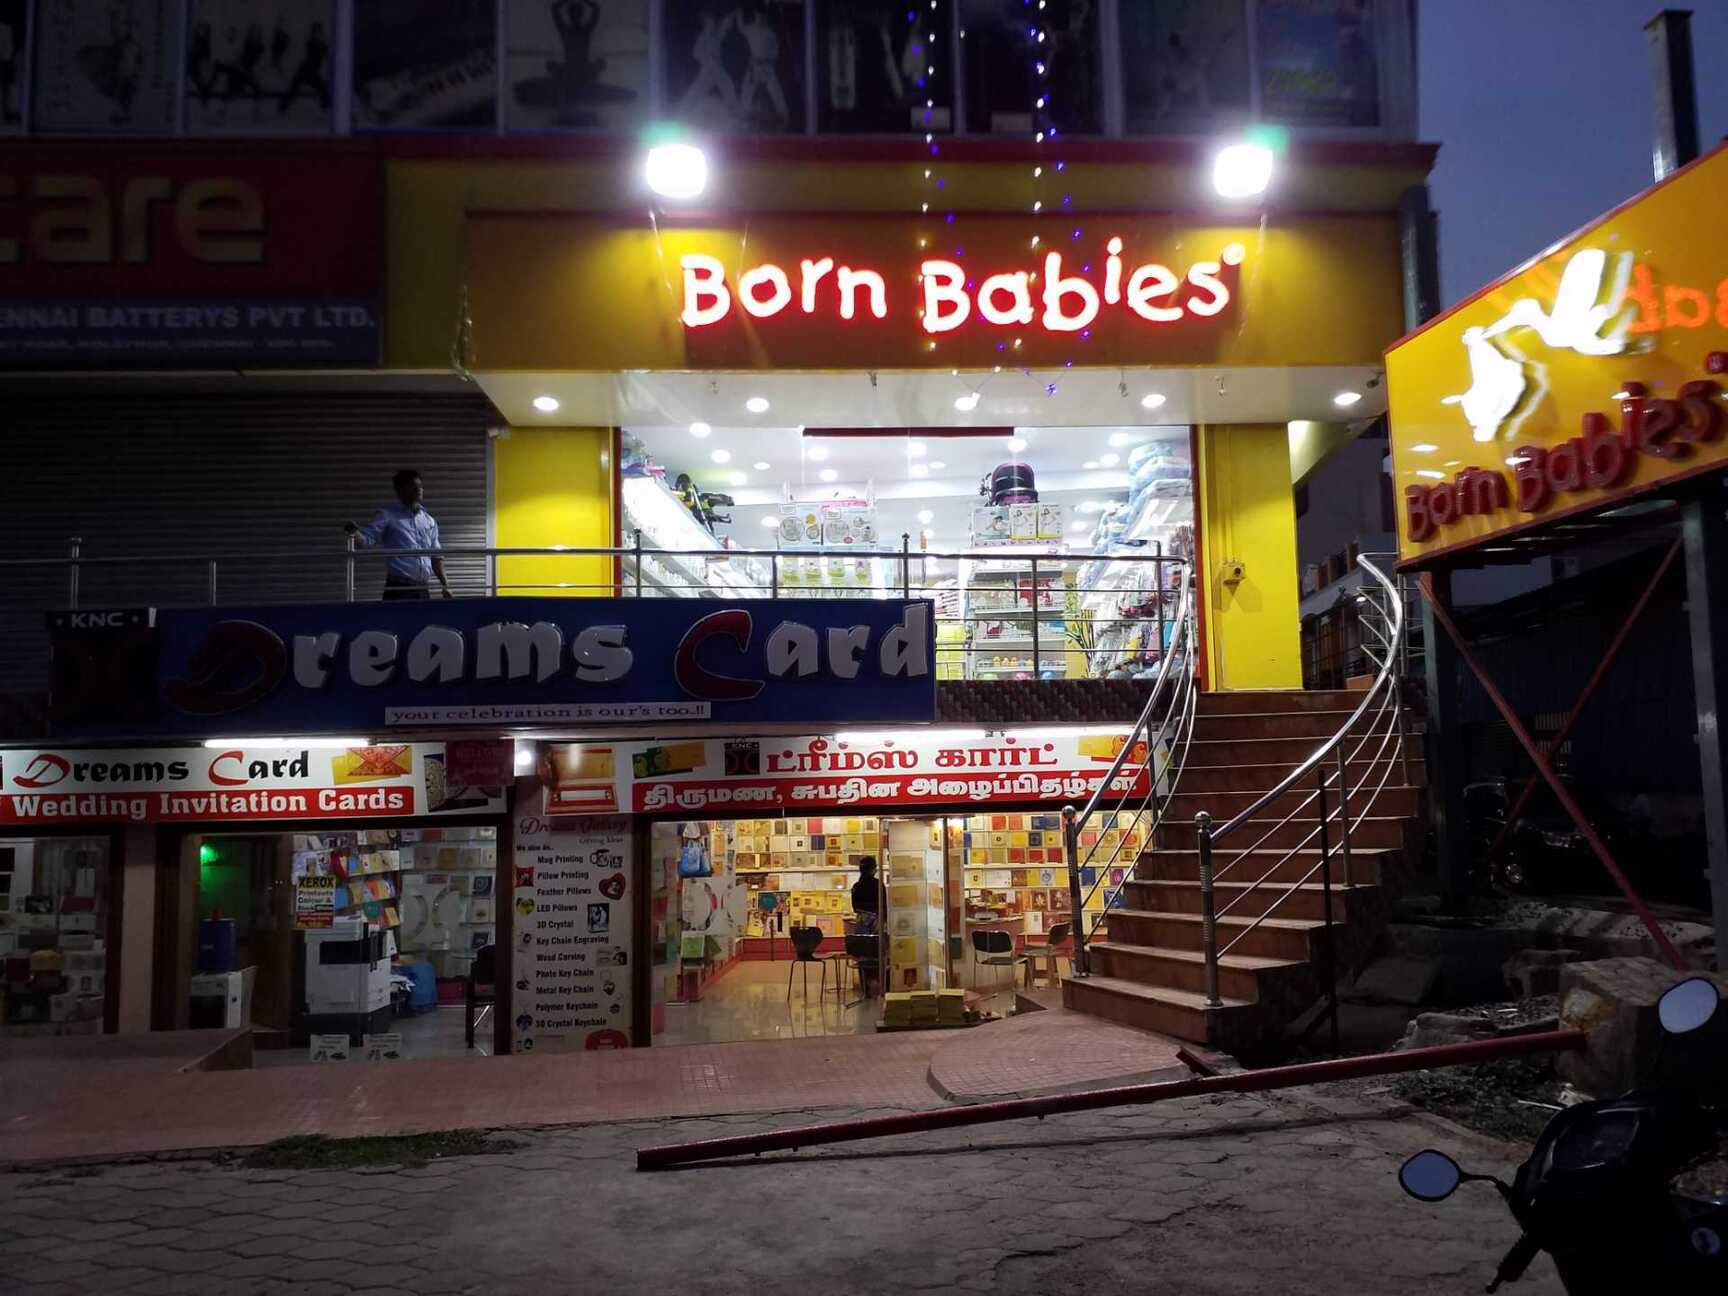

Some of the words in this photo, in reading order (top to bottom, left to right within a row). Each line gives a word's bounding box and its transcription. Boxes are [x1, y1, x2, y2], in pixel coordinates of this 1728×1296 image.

[680, 254, 888, 328] Born
[86, 306, 241, 328] BATTERYS
[249, 306, 306, 328] PVT
[313, 306, 376, 328] LTD.
[1405, 466, 1507, 543] Born
[161, 618, 634, 717] Dreams
[674, 602, 929, 702] Card
[391, 708, 441, 722] your
[446, 705, 571, 720] celebration
[577, 705, 593, 718] is
[599, 703, 651, 717] our's
[766, 736, 919, 773] ட்ரீம்ஸ்
[934, 737, 1059, 768] கார்ட்
[13, 753, 190, 788] Dreams
[208, 750, 309, 786] Card
[790, 776, 901, 804] சுபதின
[12, 793, 147, 820] Wedding
[159, 789, 307, 817] Invitation
[318, 787, 405, 812] Cards
[537, 855, 553, 864] Mug
[555, 855, 584, 864] Printing
[298, 876, 335, 889] XEROX
[537, 871, 559, 880] Pillow
[561, 871, 589, 880] Printing
[536, 903, 551, 913] LED
[548, 919, 574, 931] Crystal
[536, 936, 549, 946] Key
[551, 935, 572, 945] Chain
[574, 935, 609, 946] Engraving
[559, 968, 572, 979] Key
[573, 967, 594, 977] Chain
[559, 985, 572, 995] Key
[573, 984, 594, 994] Chain
